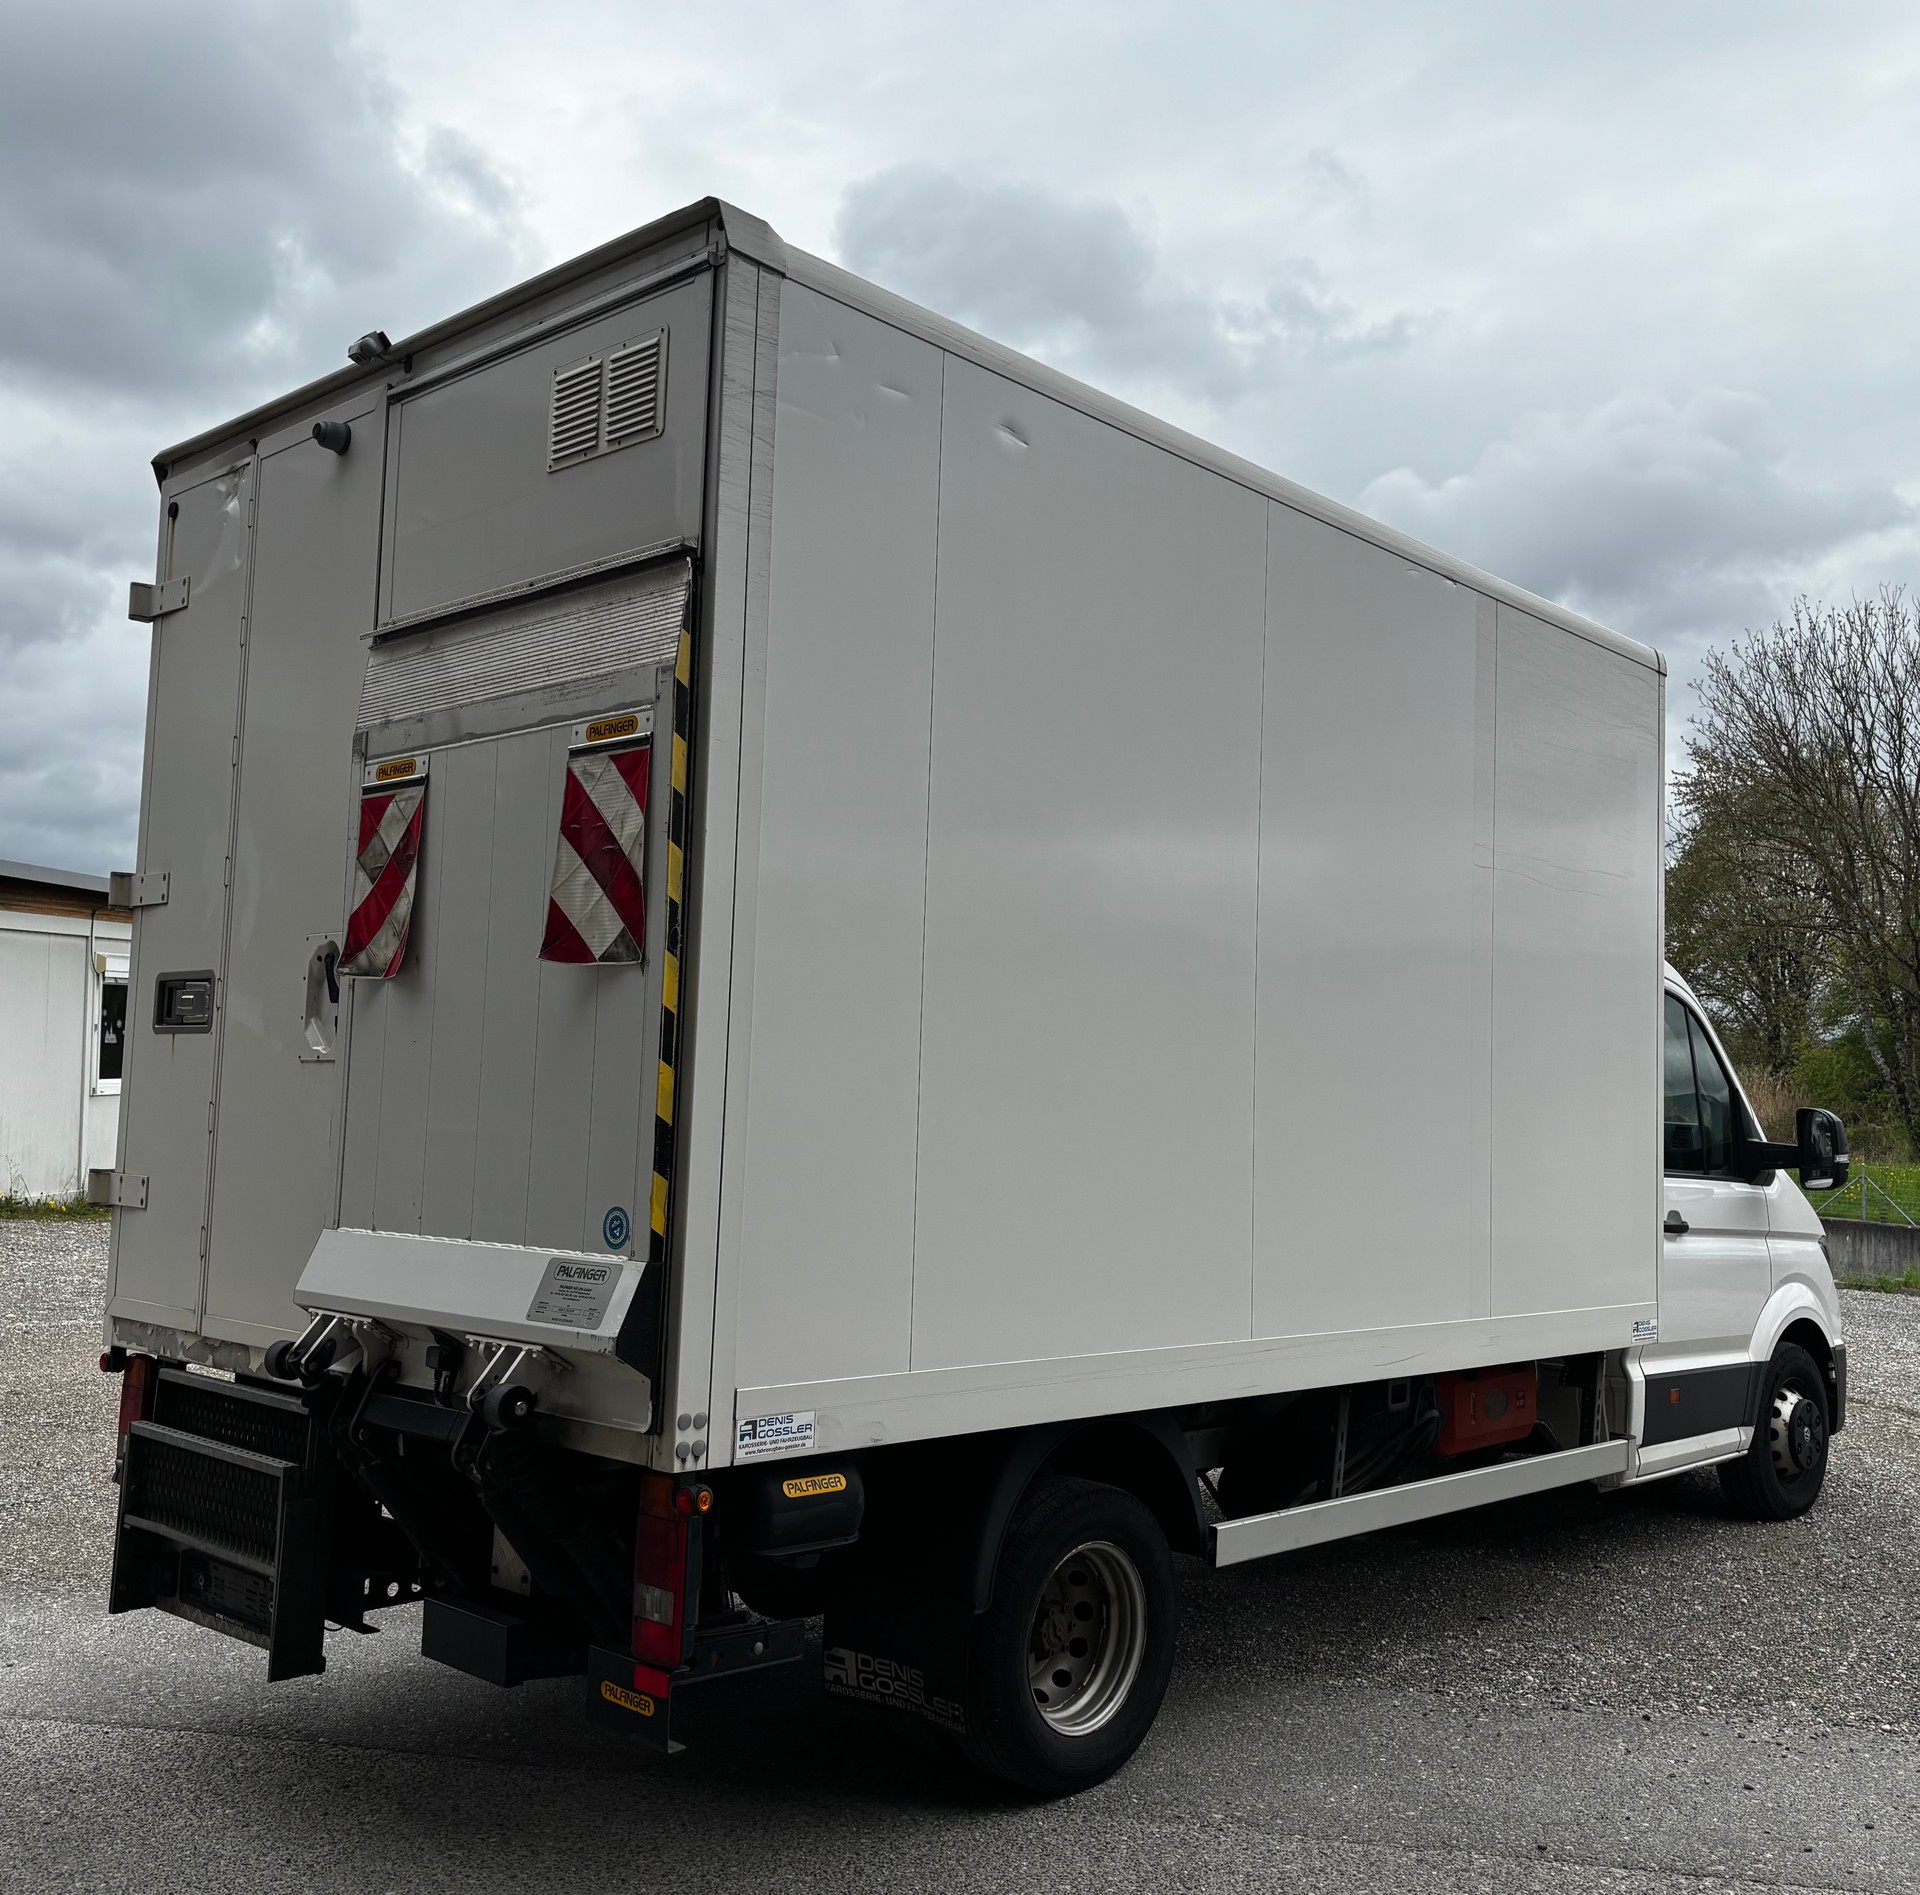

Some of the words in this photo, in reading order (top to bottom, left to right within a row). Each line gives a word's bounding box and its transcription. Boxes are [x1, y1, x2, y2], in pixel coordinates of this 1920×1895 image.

[590, 719, 634, 738] PALFINGER
[378, 762, 414, 778] PALFINGER
[556, 1265, 607, 1282] PALFINGER
[758, 1414, 794, 1428] DENIS
[758, 1423, 813, 1439] GOSSLER
[739, 1441, 769, 1450] KAROSSERIE-
[780, 1434, 813, 1444] FAHRZEUGBAU
[787, 1476, 843, 1495] PALFINGER
[857, 1652, 924, 1688] DENIS
[604, 1683, 651, 1714] PALFINGER
[824, 1681, 884, 1703] KAROSSERIE-
[885, 1696, 906, 1709] UND
[859, 1673, 964, 1722] GOSSLER
